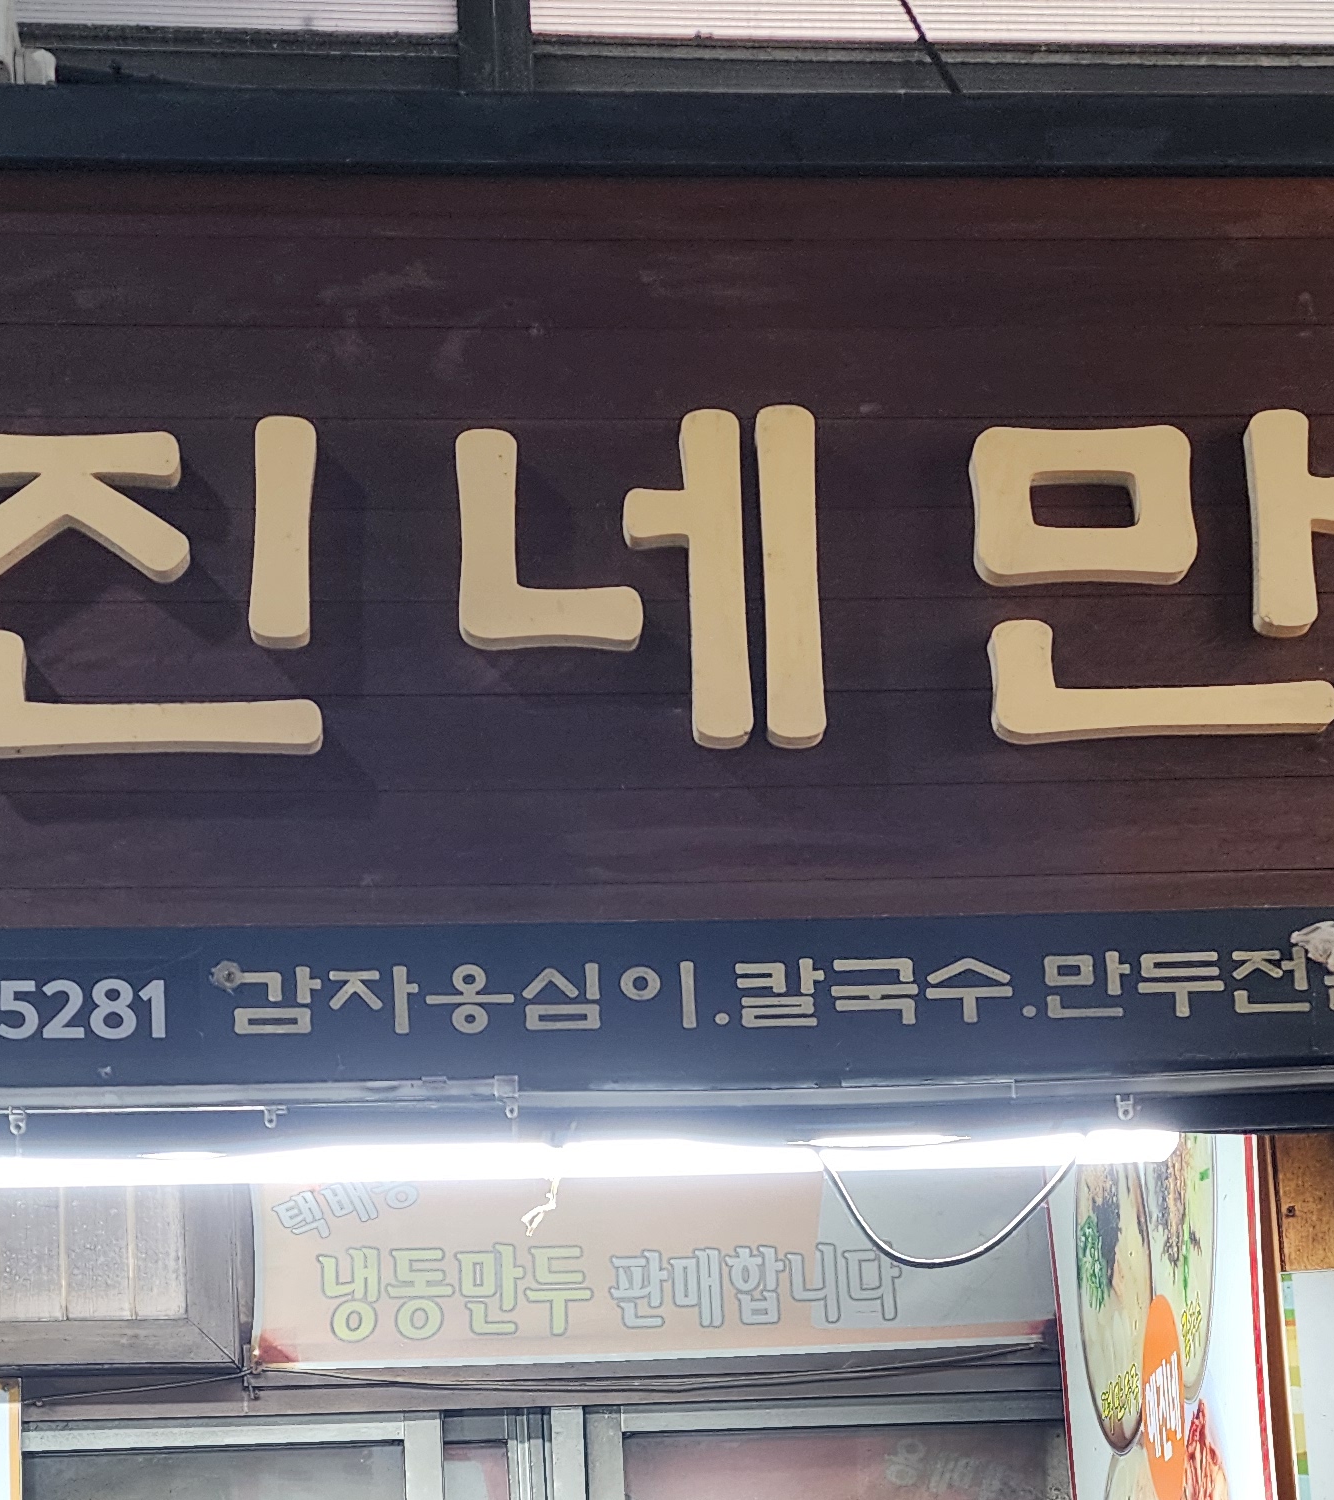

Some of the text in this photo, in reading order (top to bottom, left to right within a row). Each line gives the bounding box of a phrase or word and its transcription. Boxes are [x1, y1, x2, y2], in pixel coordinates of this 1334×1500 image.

[315, 1239, 903, 1344] 냉동만두 판매합니다
[1143, 1349, 1183, 1464] 예진네
